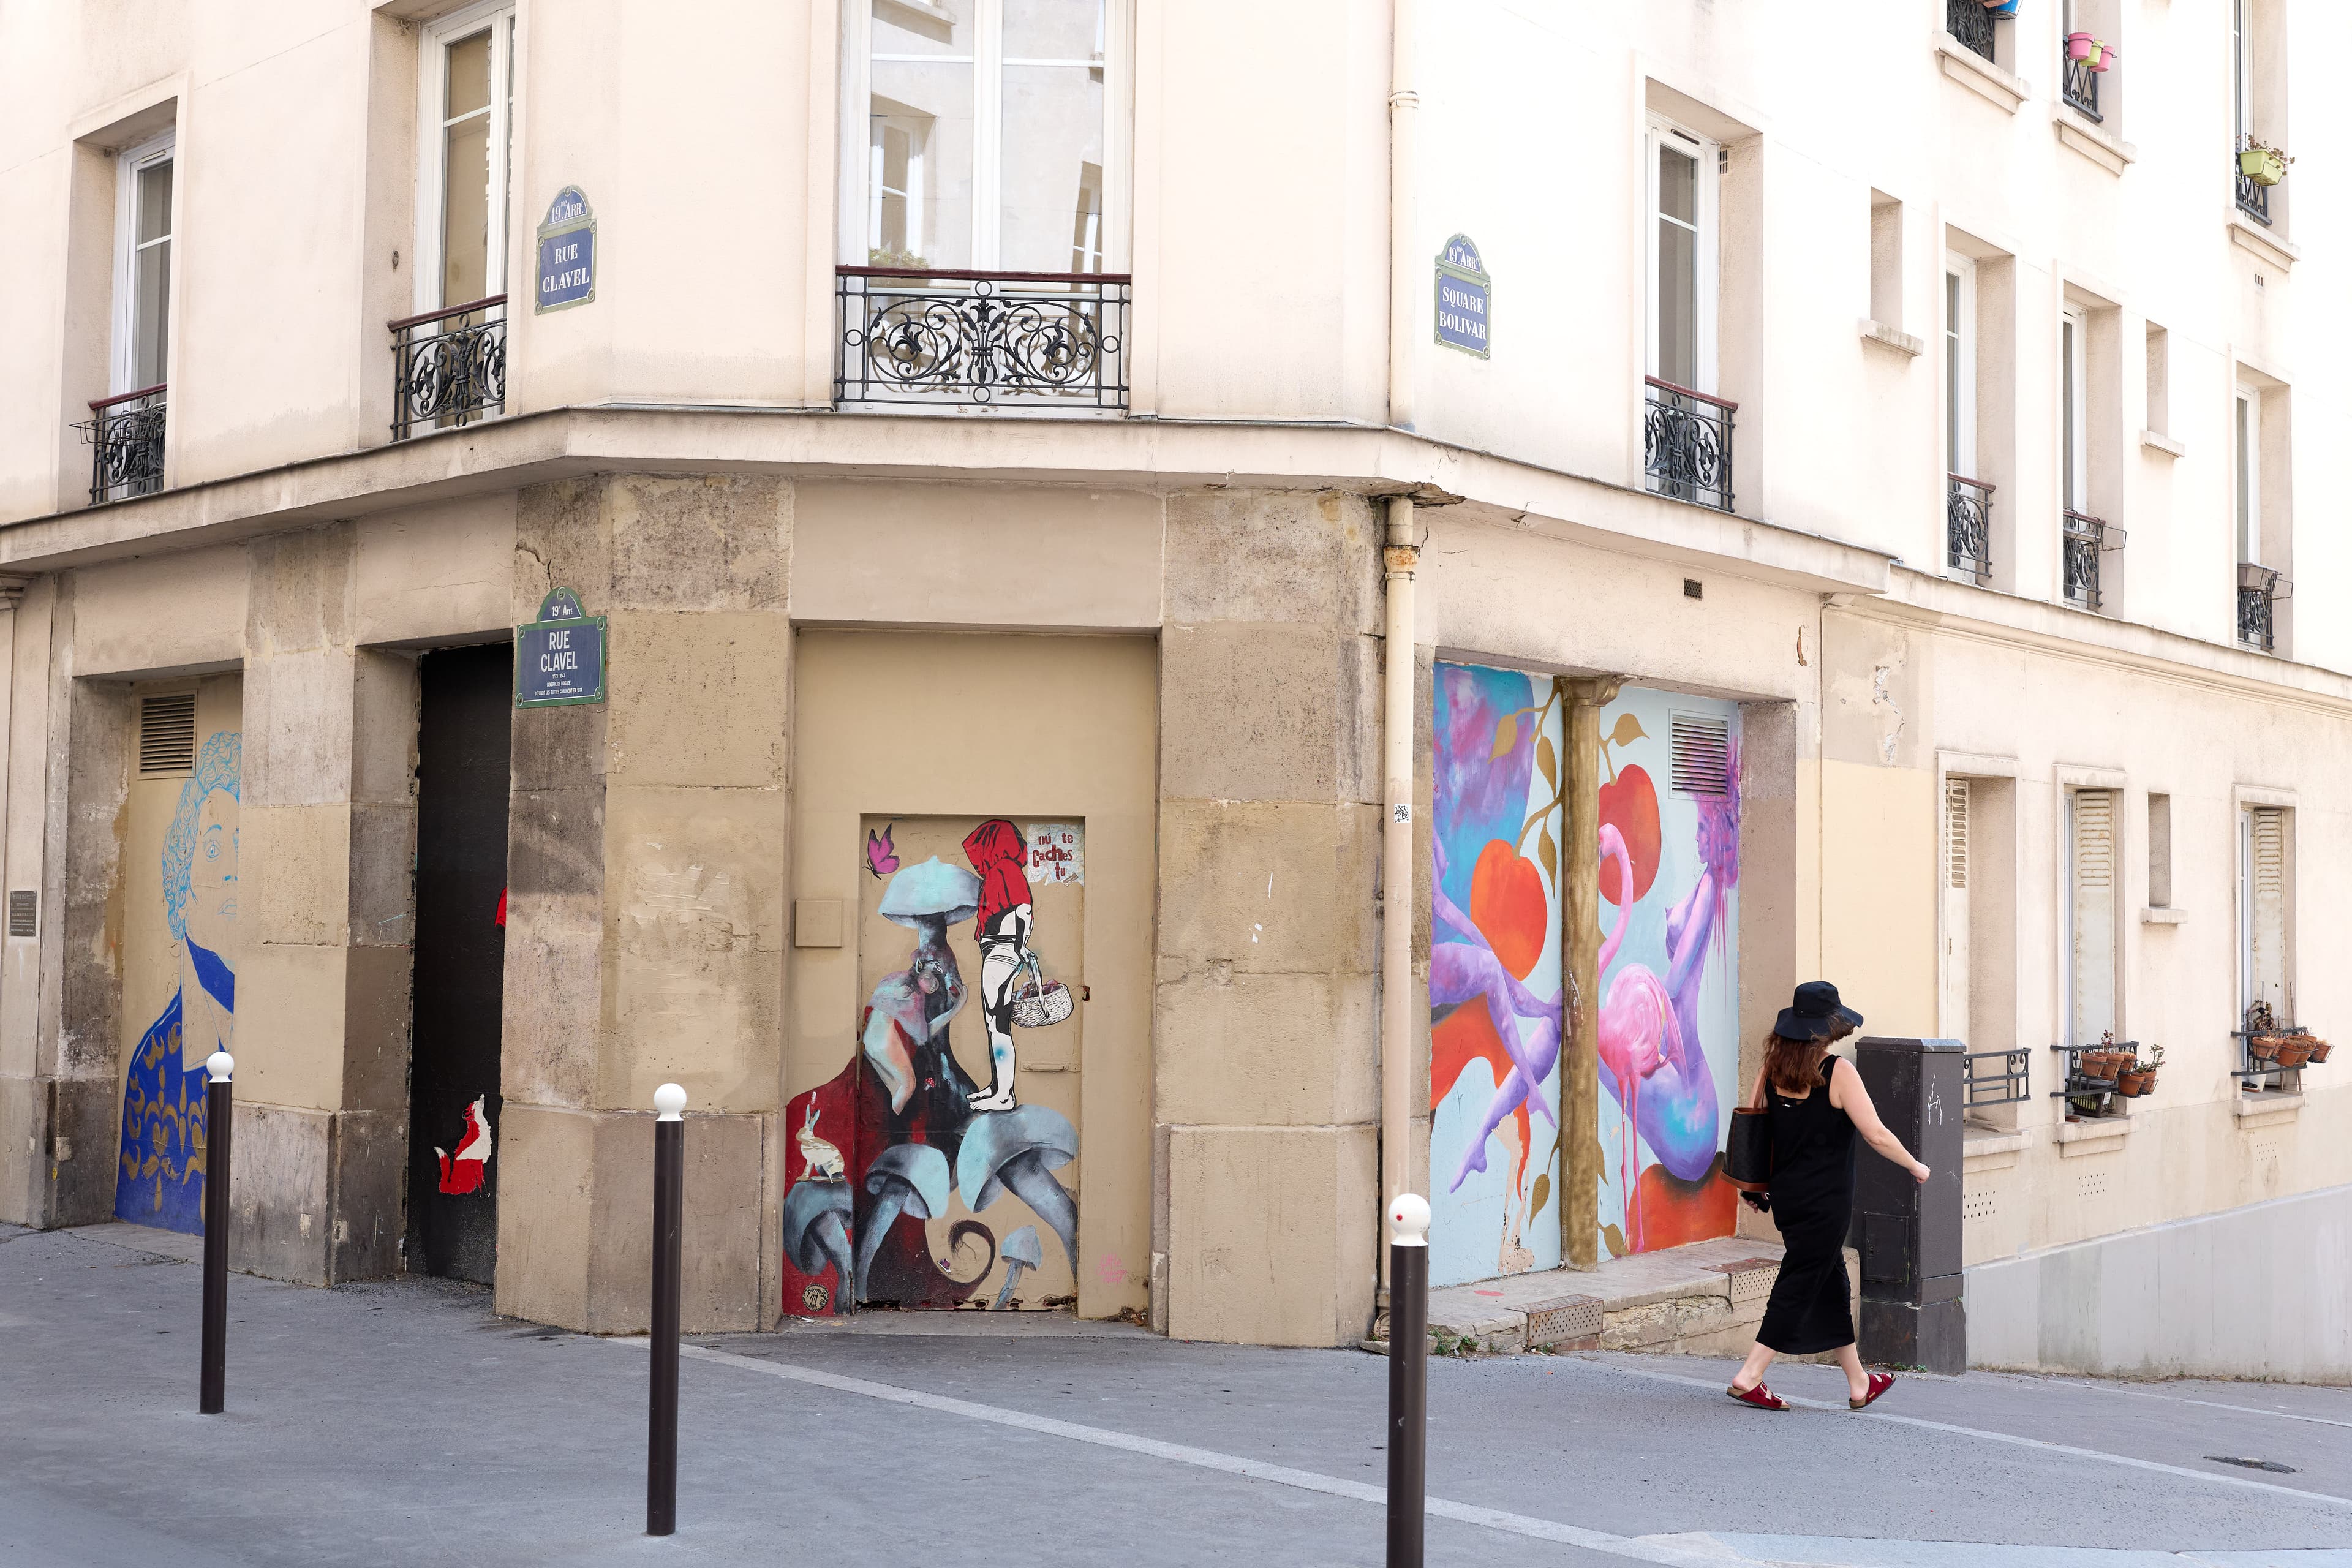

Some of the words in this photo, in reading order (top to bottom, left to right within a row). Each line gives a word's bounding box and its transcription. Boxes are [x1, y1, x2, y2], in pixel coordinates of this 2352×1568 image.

[555, 244, 578, 264] RUE
[543, 268, 589, 293] CLAVEL
[1442, 286, 1483, 314] SQUARE
[1439, 311, 1487, 341] BOLIVAR
[549, 630, 570, 650] RUE
[541, 651, 578, 673] CLAVEL
[1062, 832, 1073, 843] te
[1055, 862, 1066, 880] tu
